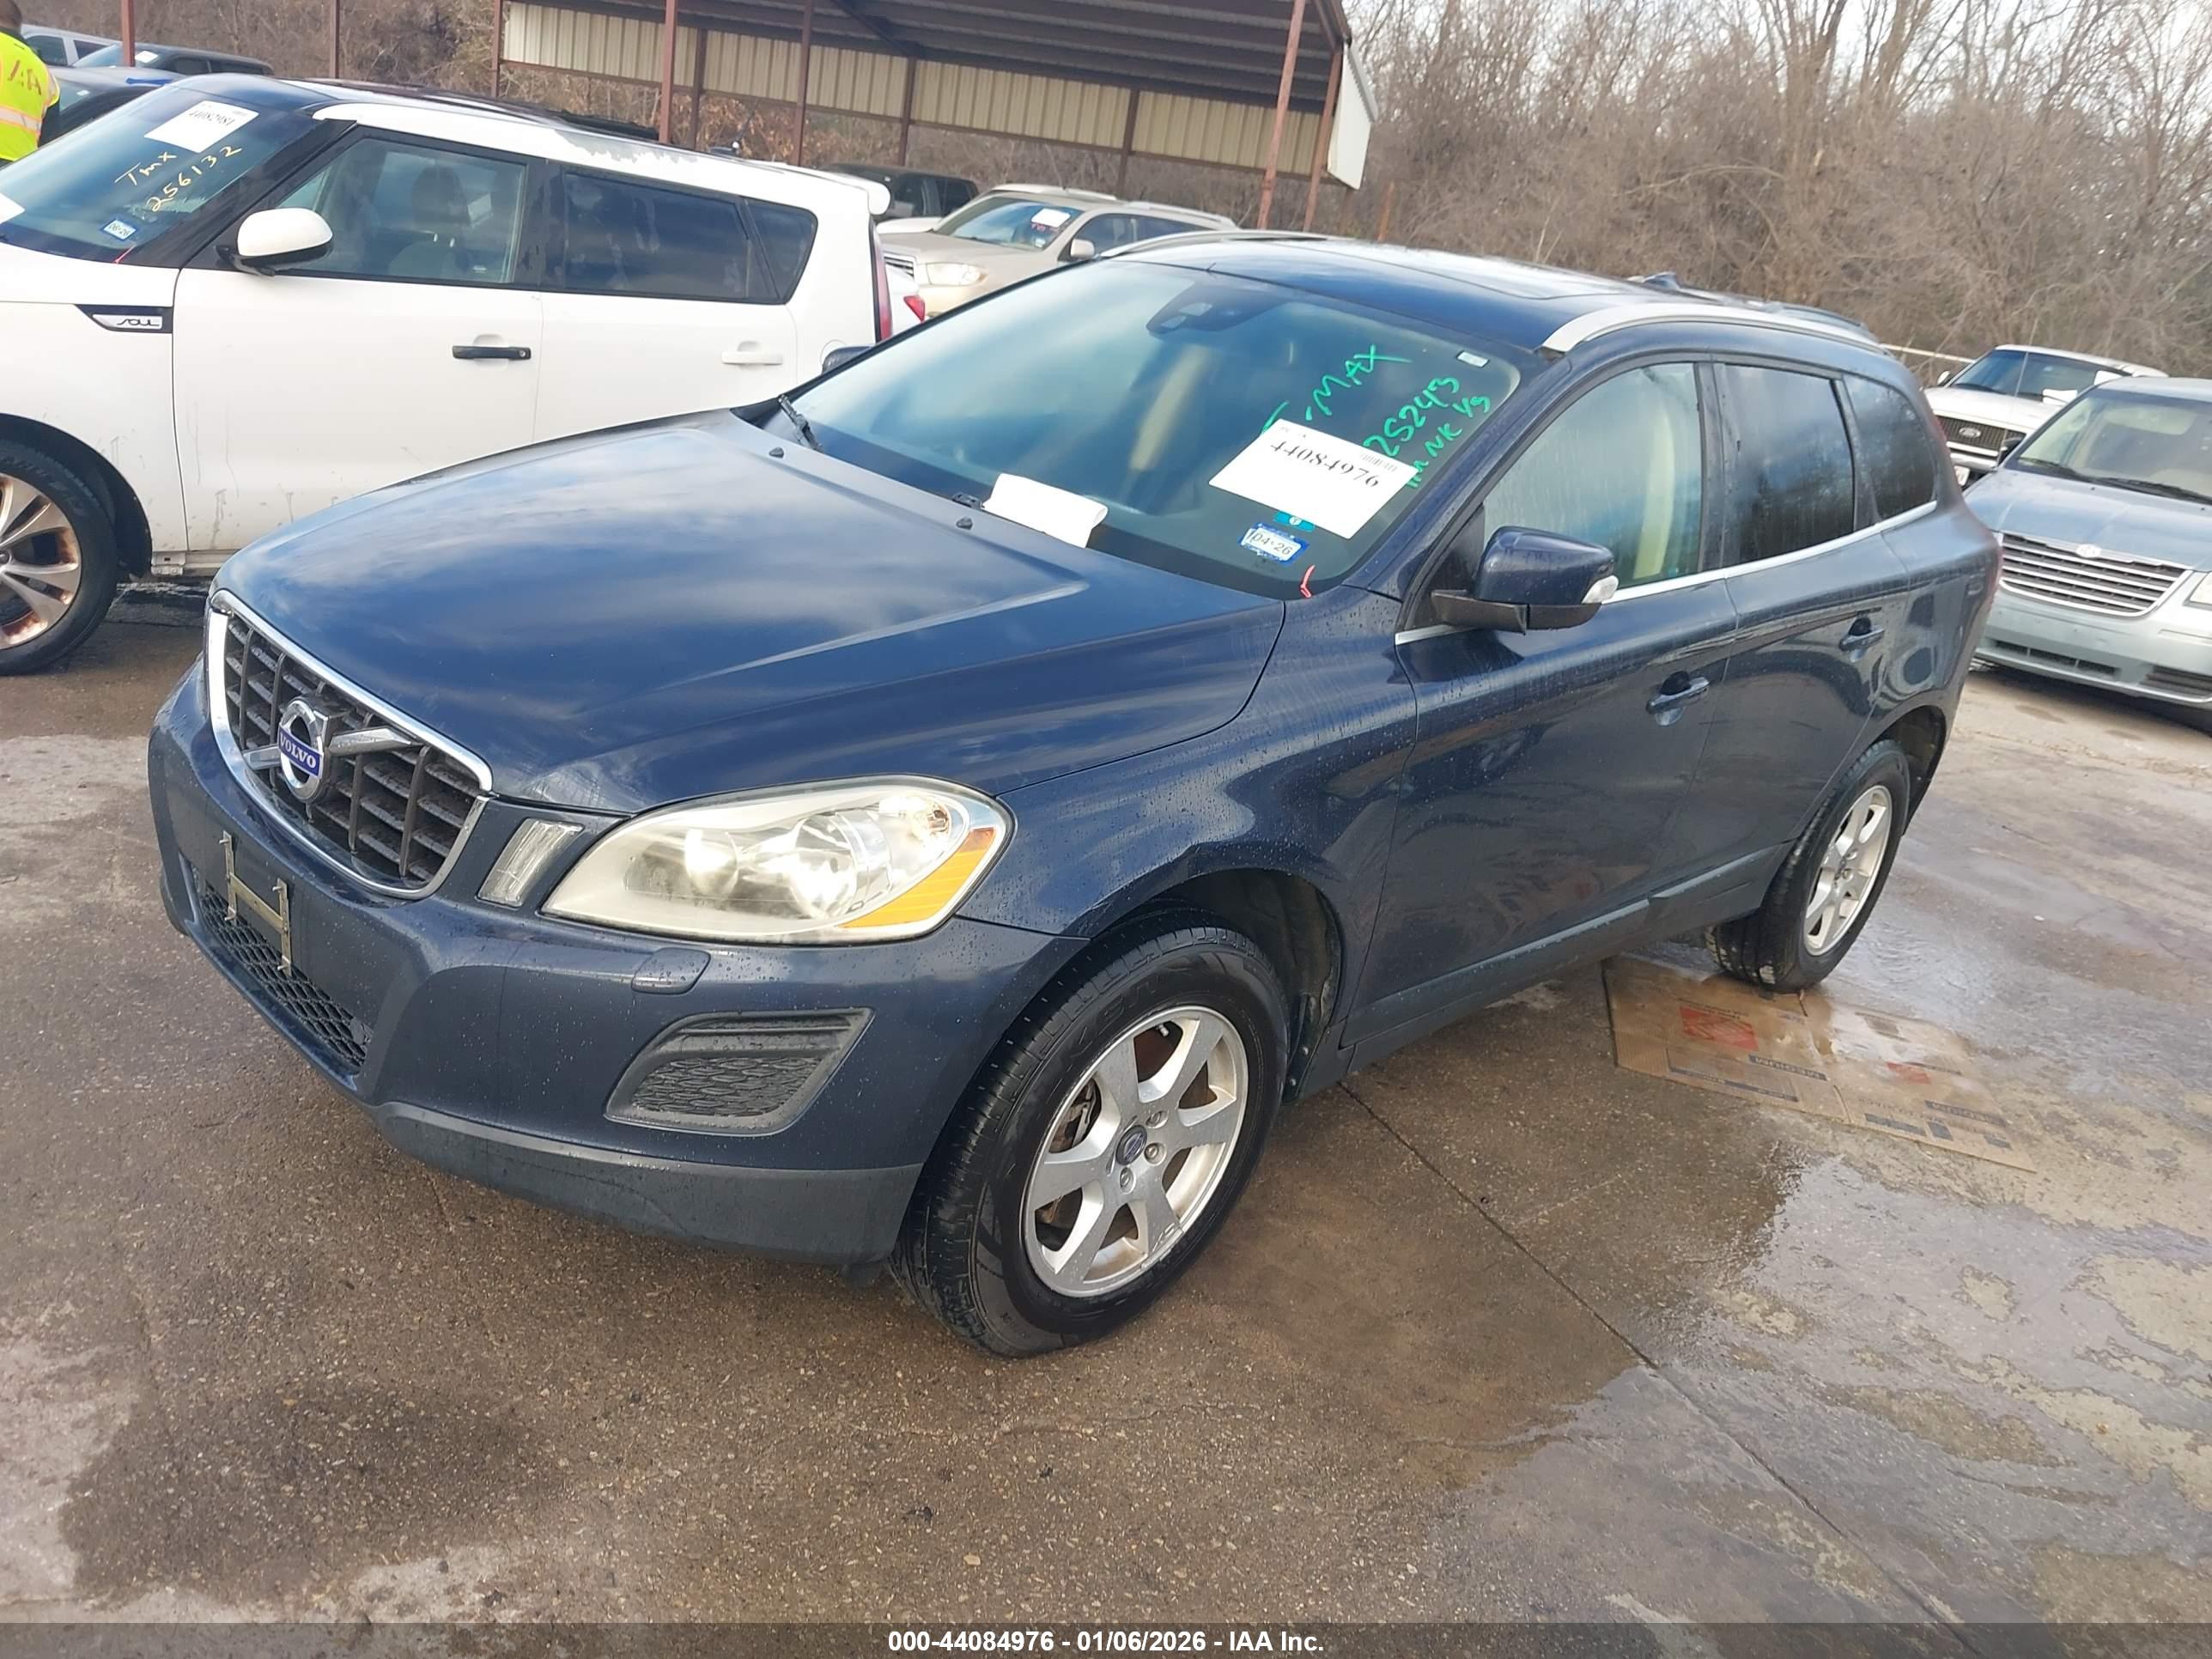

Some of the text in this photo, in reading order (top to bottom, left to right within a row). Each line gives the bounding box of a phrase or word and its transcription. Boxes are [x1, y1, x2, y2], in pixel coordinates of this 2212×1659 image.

[144, 145, 242, 212] 256132
[1270, 440, 1380, 488] 44084976
[279, 732, 318, 769] VOLVO
